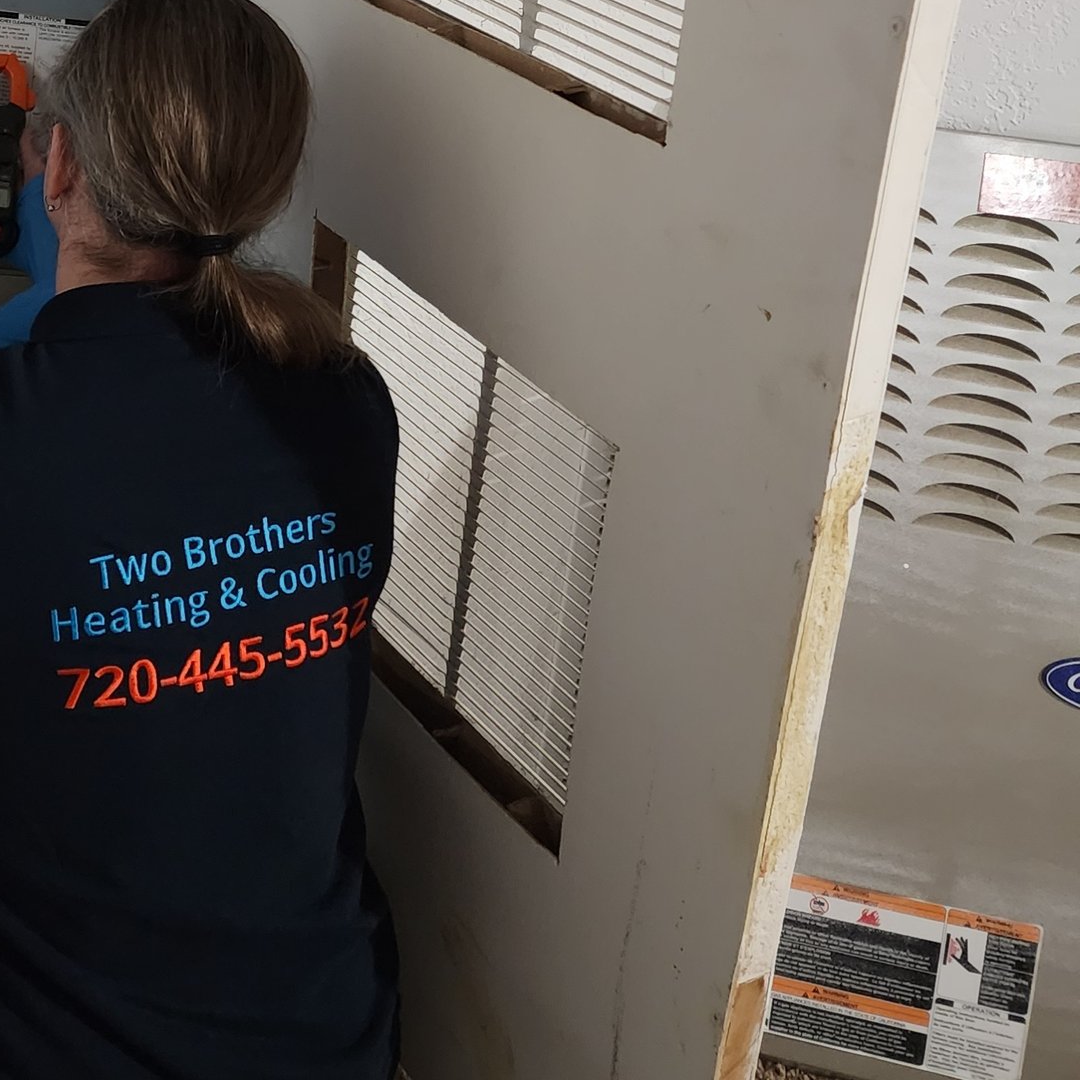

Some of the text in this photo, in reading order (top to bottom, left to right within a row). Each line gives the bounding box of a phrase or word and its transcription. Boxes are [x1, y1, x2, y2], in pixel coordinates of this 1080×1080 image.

[50, 543, 375, 643] Heating & Cooling
[89, 511, 337, 590] Two Brothers
[56, 596, 370, 710] 720-445-5532
